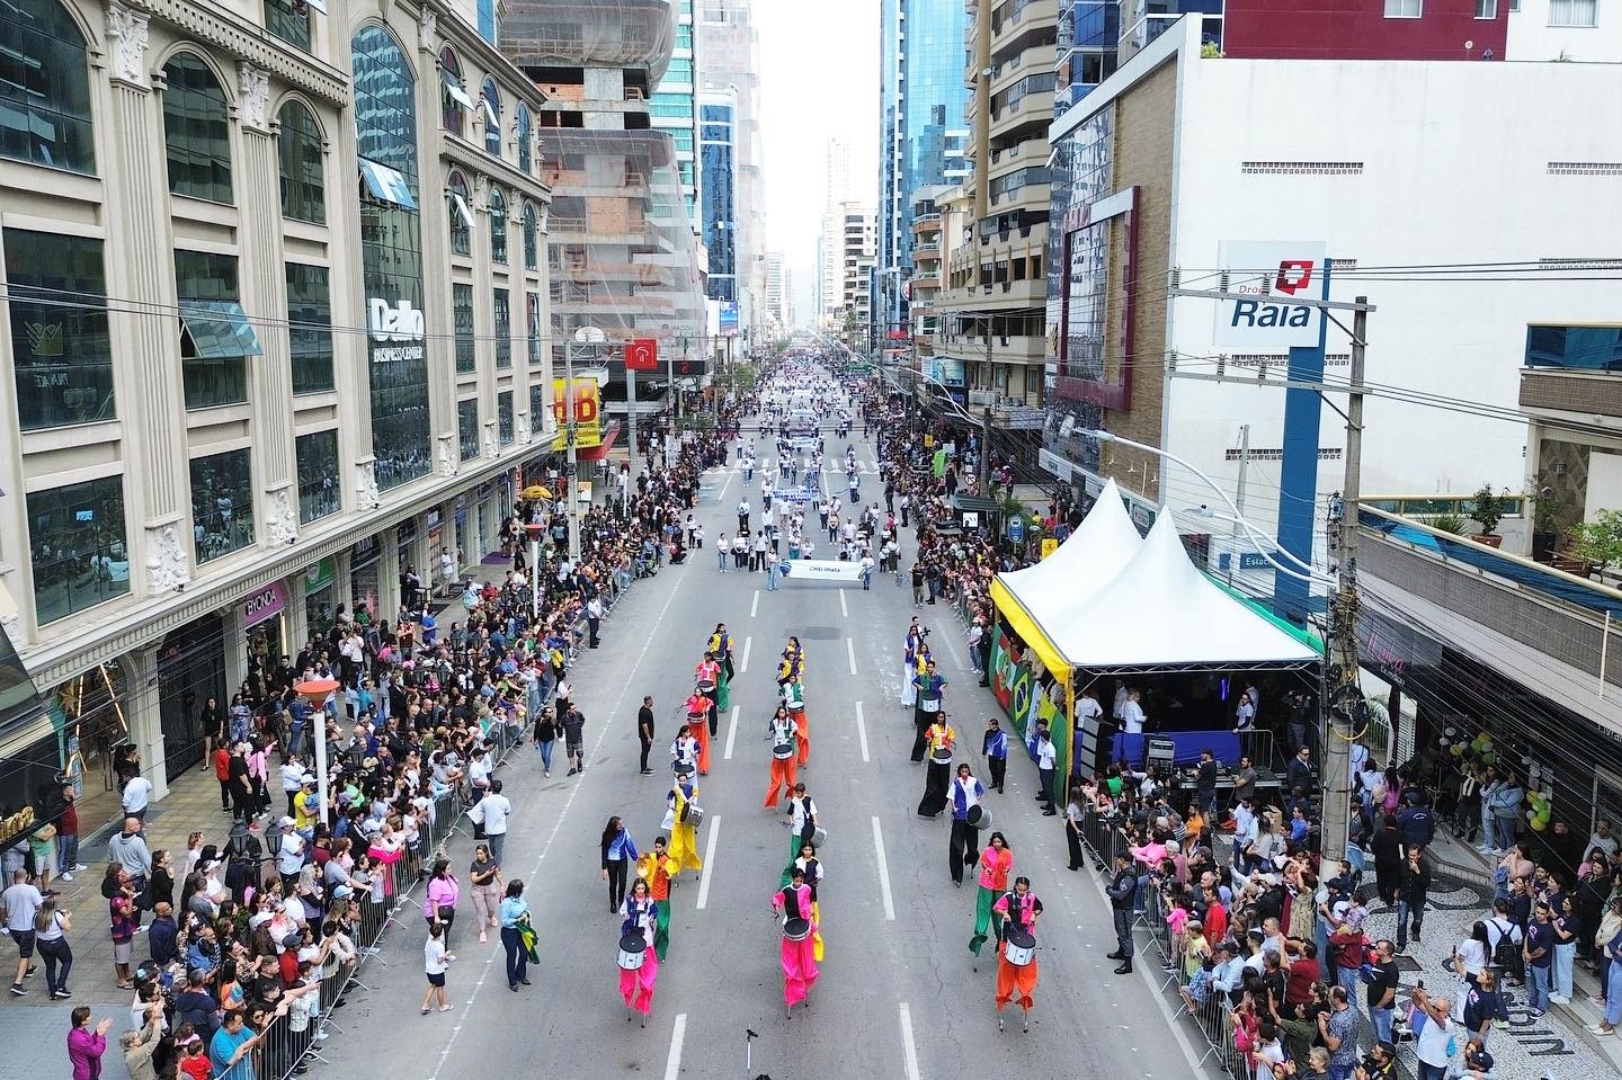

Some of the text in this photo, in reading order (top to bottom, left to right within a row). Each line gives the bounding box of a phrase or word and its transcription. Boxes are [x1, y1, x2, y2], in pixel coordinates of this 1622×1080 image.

[1231, 299, 1311, 327] Raia
[373, 346, 424, 363] BUSINESS CENTER
